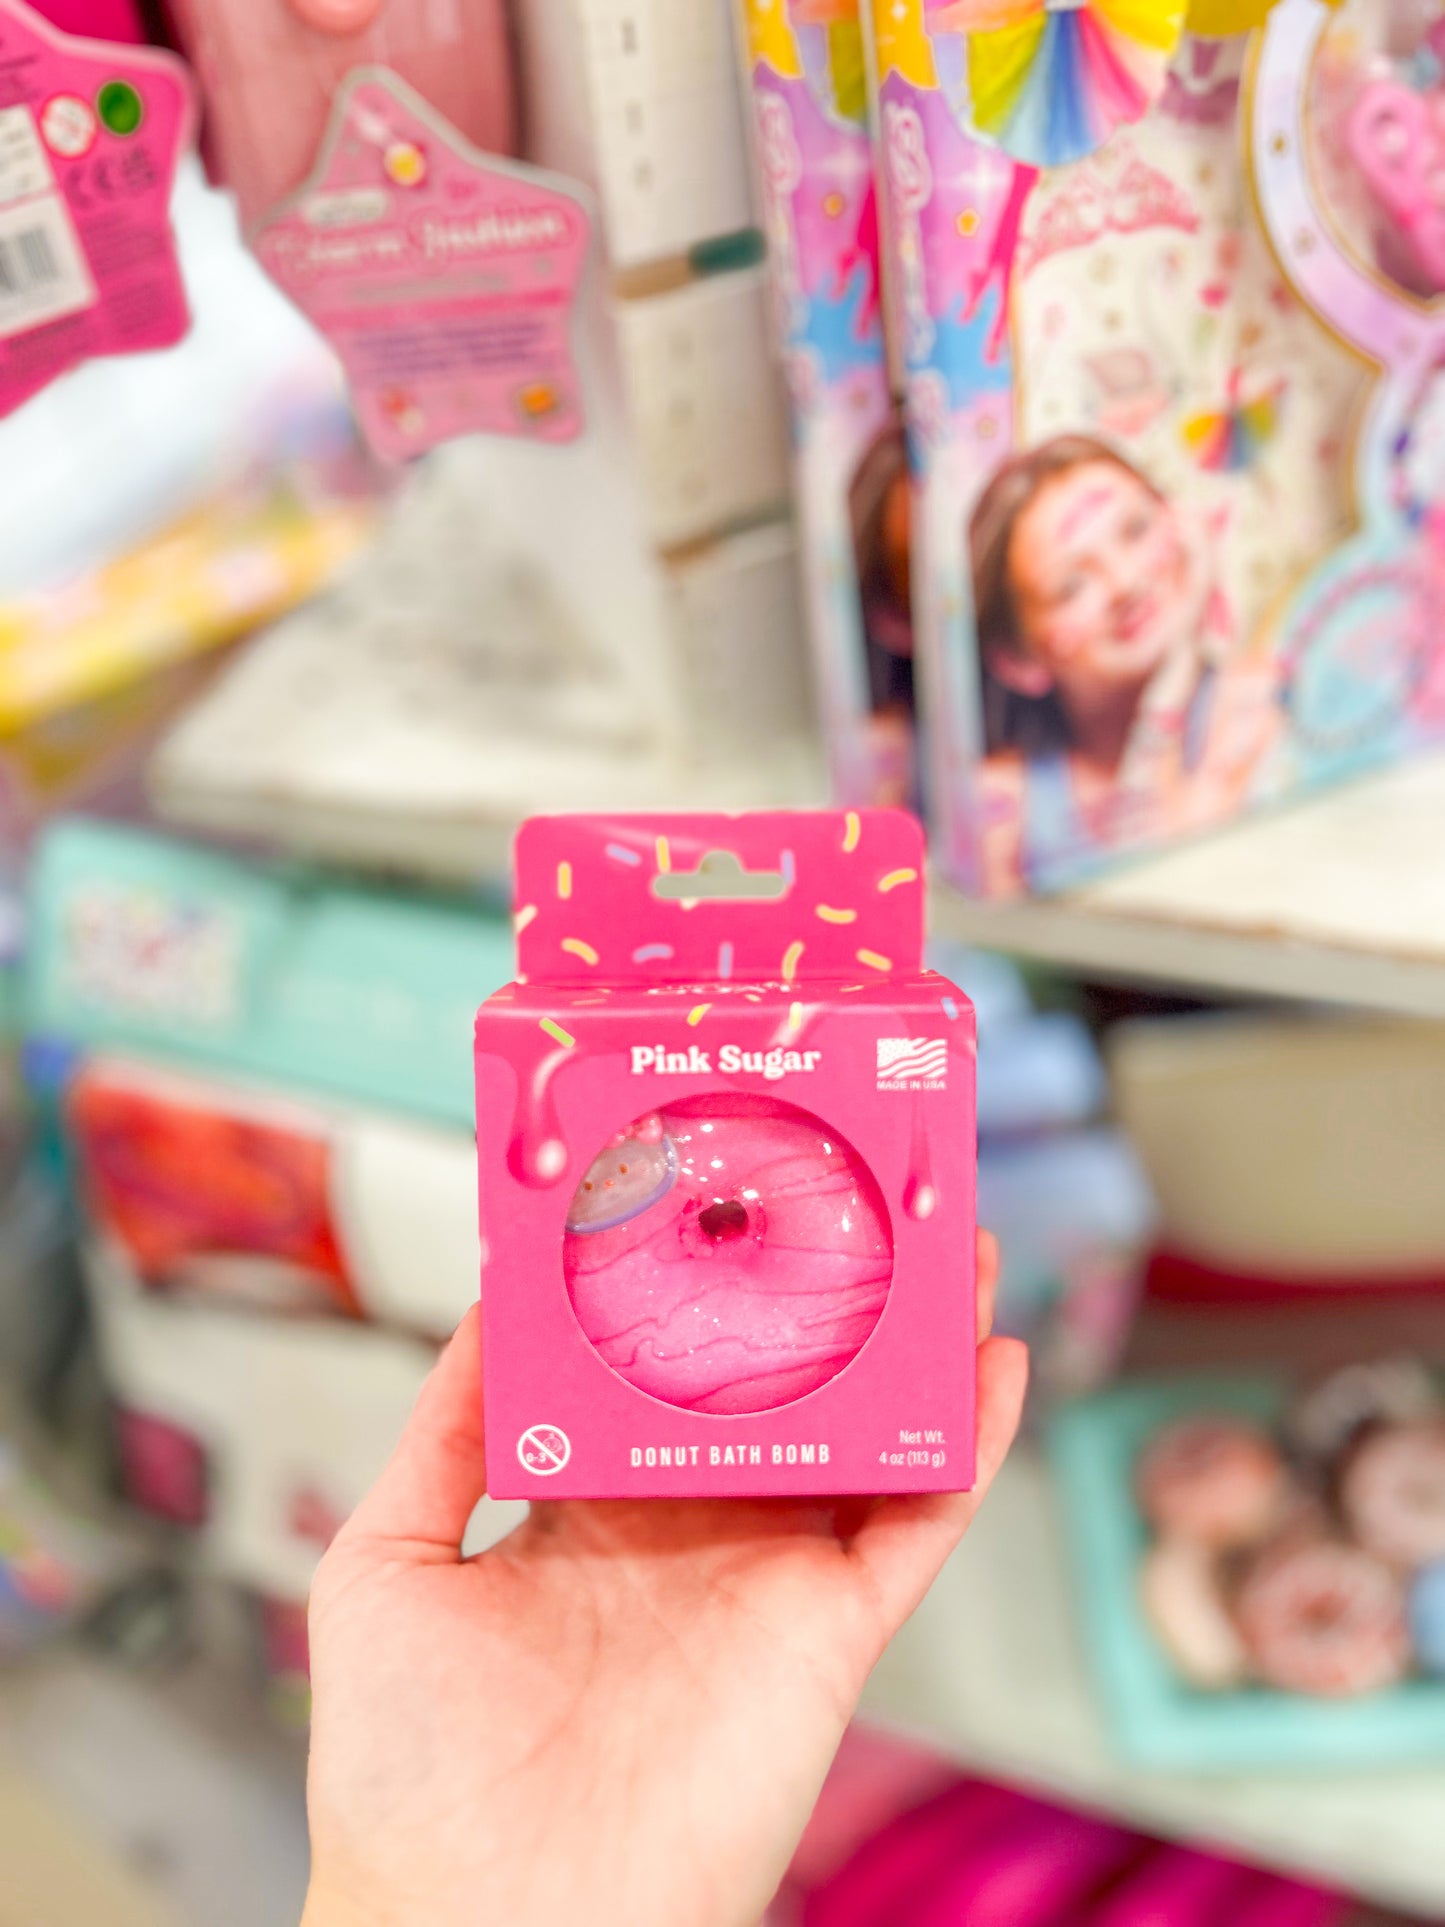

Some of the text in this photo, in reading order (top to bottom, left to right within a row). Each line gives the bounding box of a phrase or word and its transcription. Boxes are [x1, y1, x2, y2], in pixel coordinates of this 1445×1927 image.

[631, 1044, 821, 1080] Pink Sugar
[877, 1080, 945, 1090] MADE IN USA
[900, 1429, 946, 1444] Net Wt.
[630, 1443, 830, 1467] DONUT BATH BOMB
[879, 1450, 946, 1468] 4 oz (113 g)
